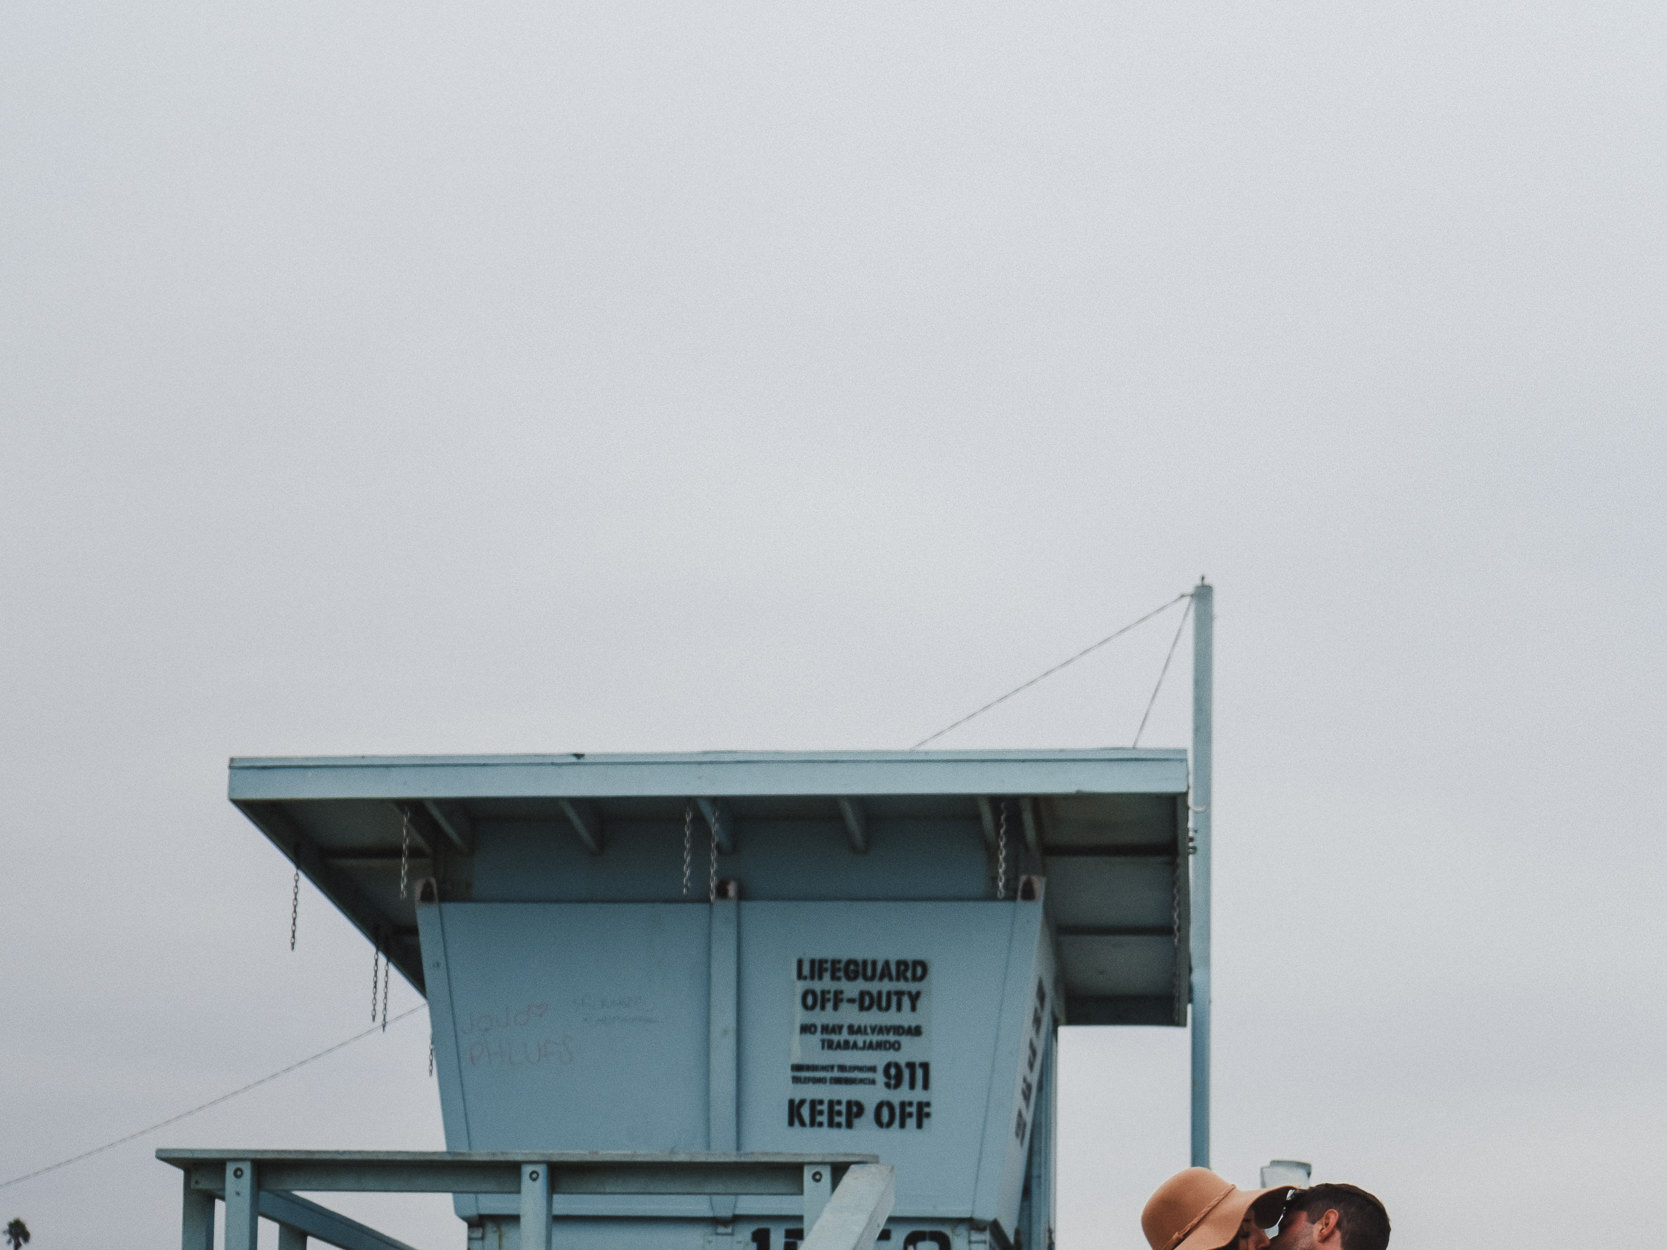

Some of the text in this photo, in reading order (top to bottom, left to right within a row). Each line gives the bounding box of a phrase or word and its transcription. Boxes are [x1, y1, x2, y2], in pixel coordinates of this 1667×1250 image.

[797, 958, 928, 982] LIFEGUARD
[801, 988, 921, 1012] OFF-DUTY
[800, 1023, 922, 1036] NO HAY SALVAVIDAS
[820, 1038, 902, 1051] TRABAJANDO
[883, 1061, 930, 1091] 911
[788, 1099, 931, 1130] KEEP OFF
